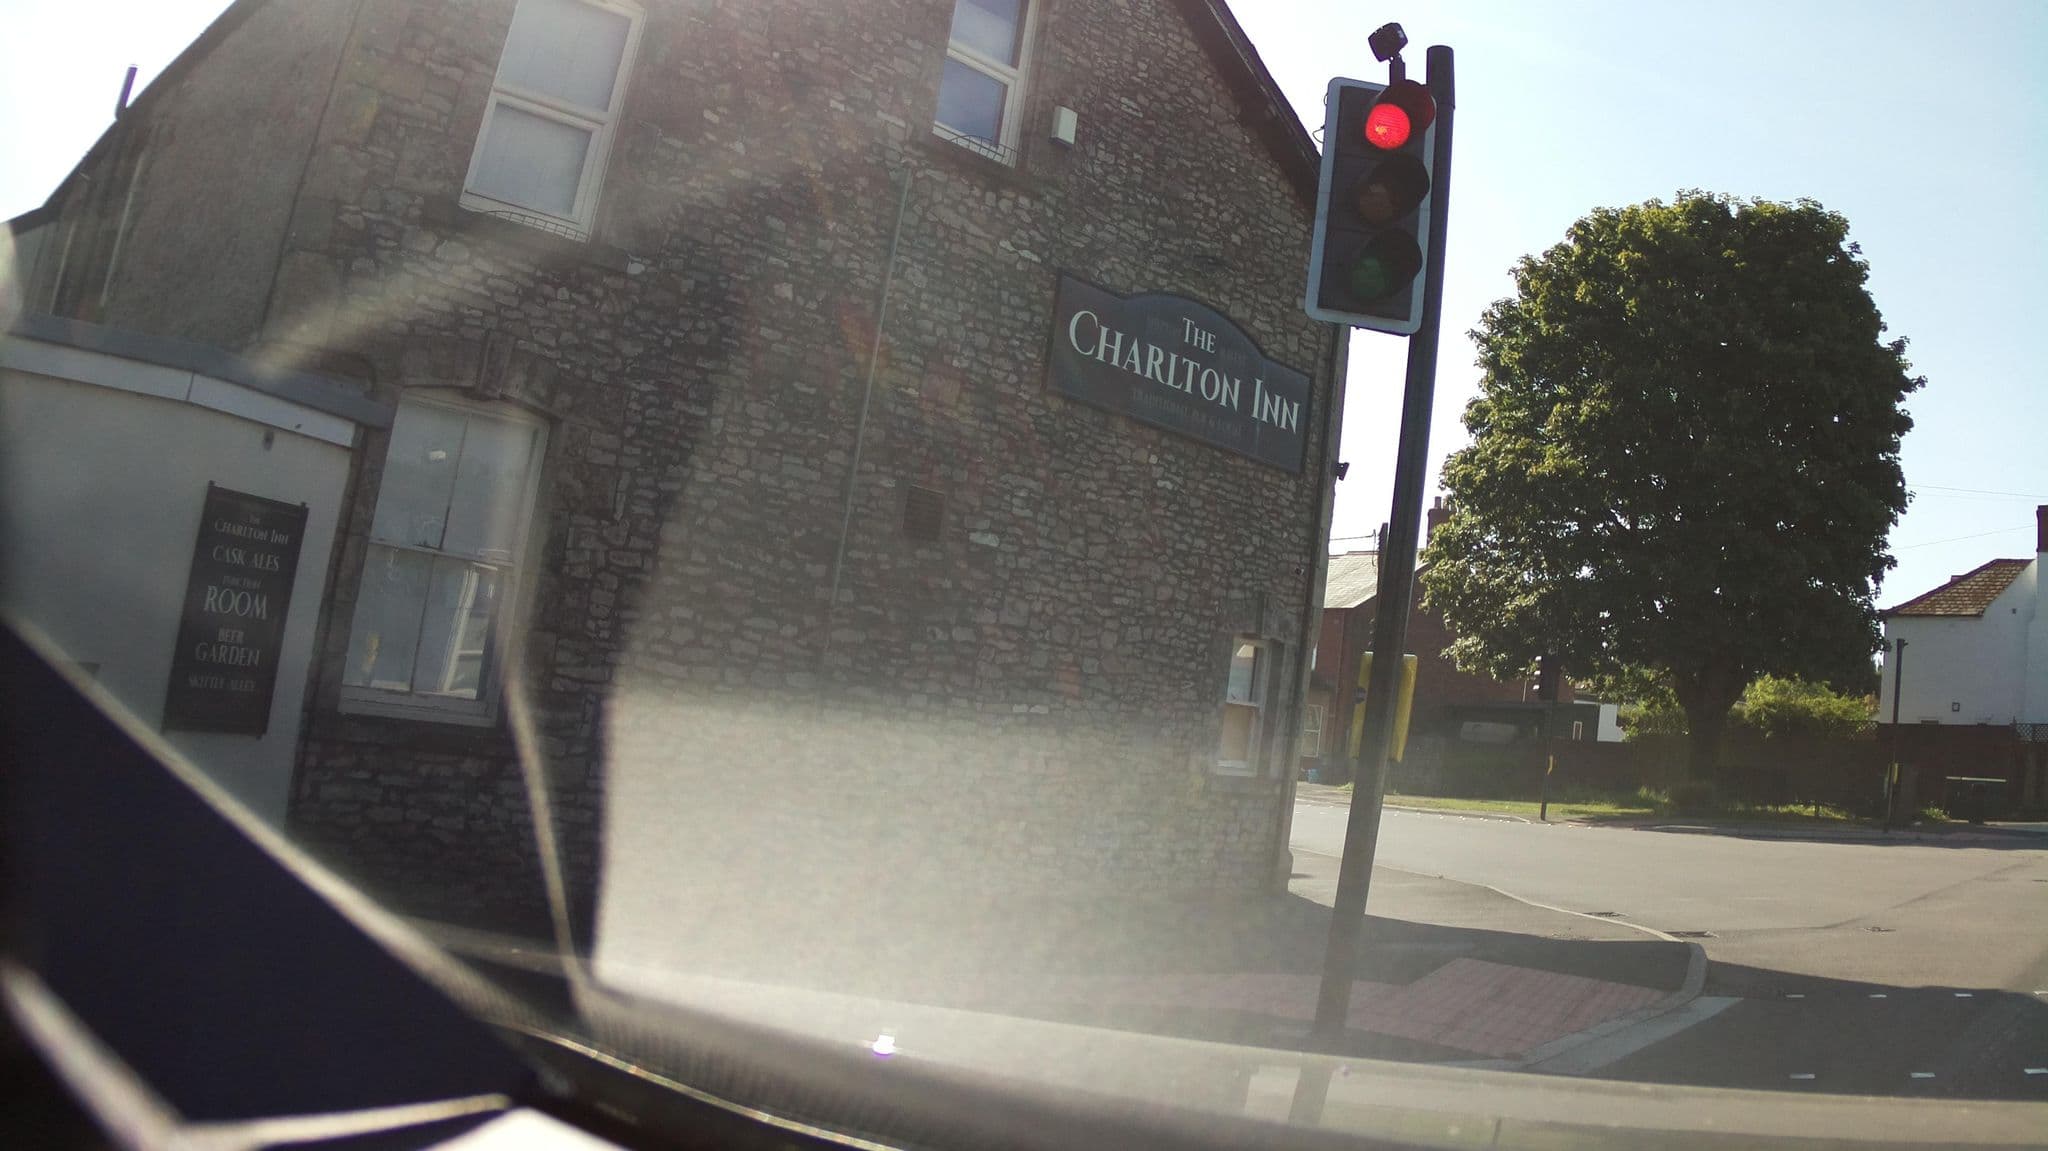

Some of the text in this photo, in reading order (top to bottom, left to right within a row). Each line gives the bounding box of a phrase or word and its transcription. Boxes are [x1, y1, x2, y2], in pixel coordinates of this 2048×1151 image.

[1182, 317, 1217, 354] THE
[1069, 310, 1241, 412] CHARLTON
[1251, 377, 1300, 434] INN
[214, 519, 289, 545] CHARLTON INN
[212, 544, 281, 572] CASK ALES
[203, 585, 268, 621] ROOM
[218, 627, 244, 643] BEER
[195, 642, 260, 667] GARDEN
